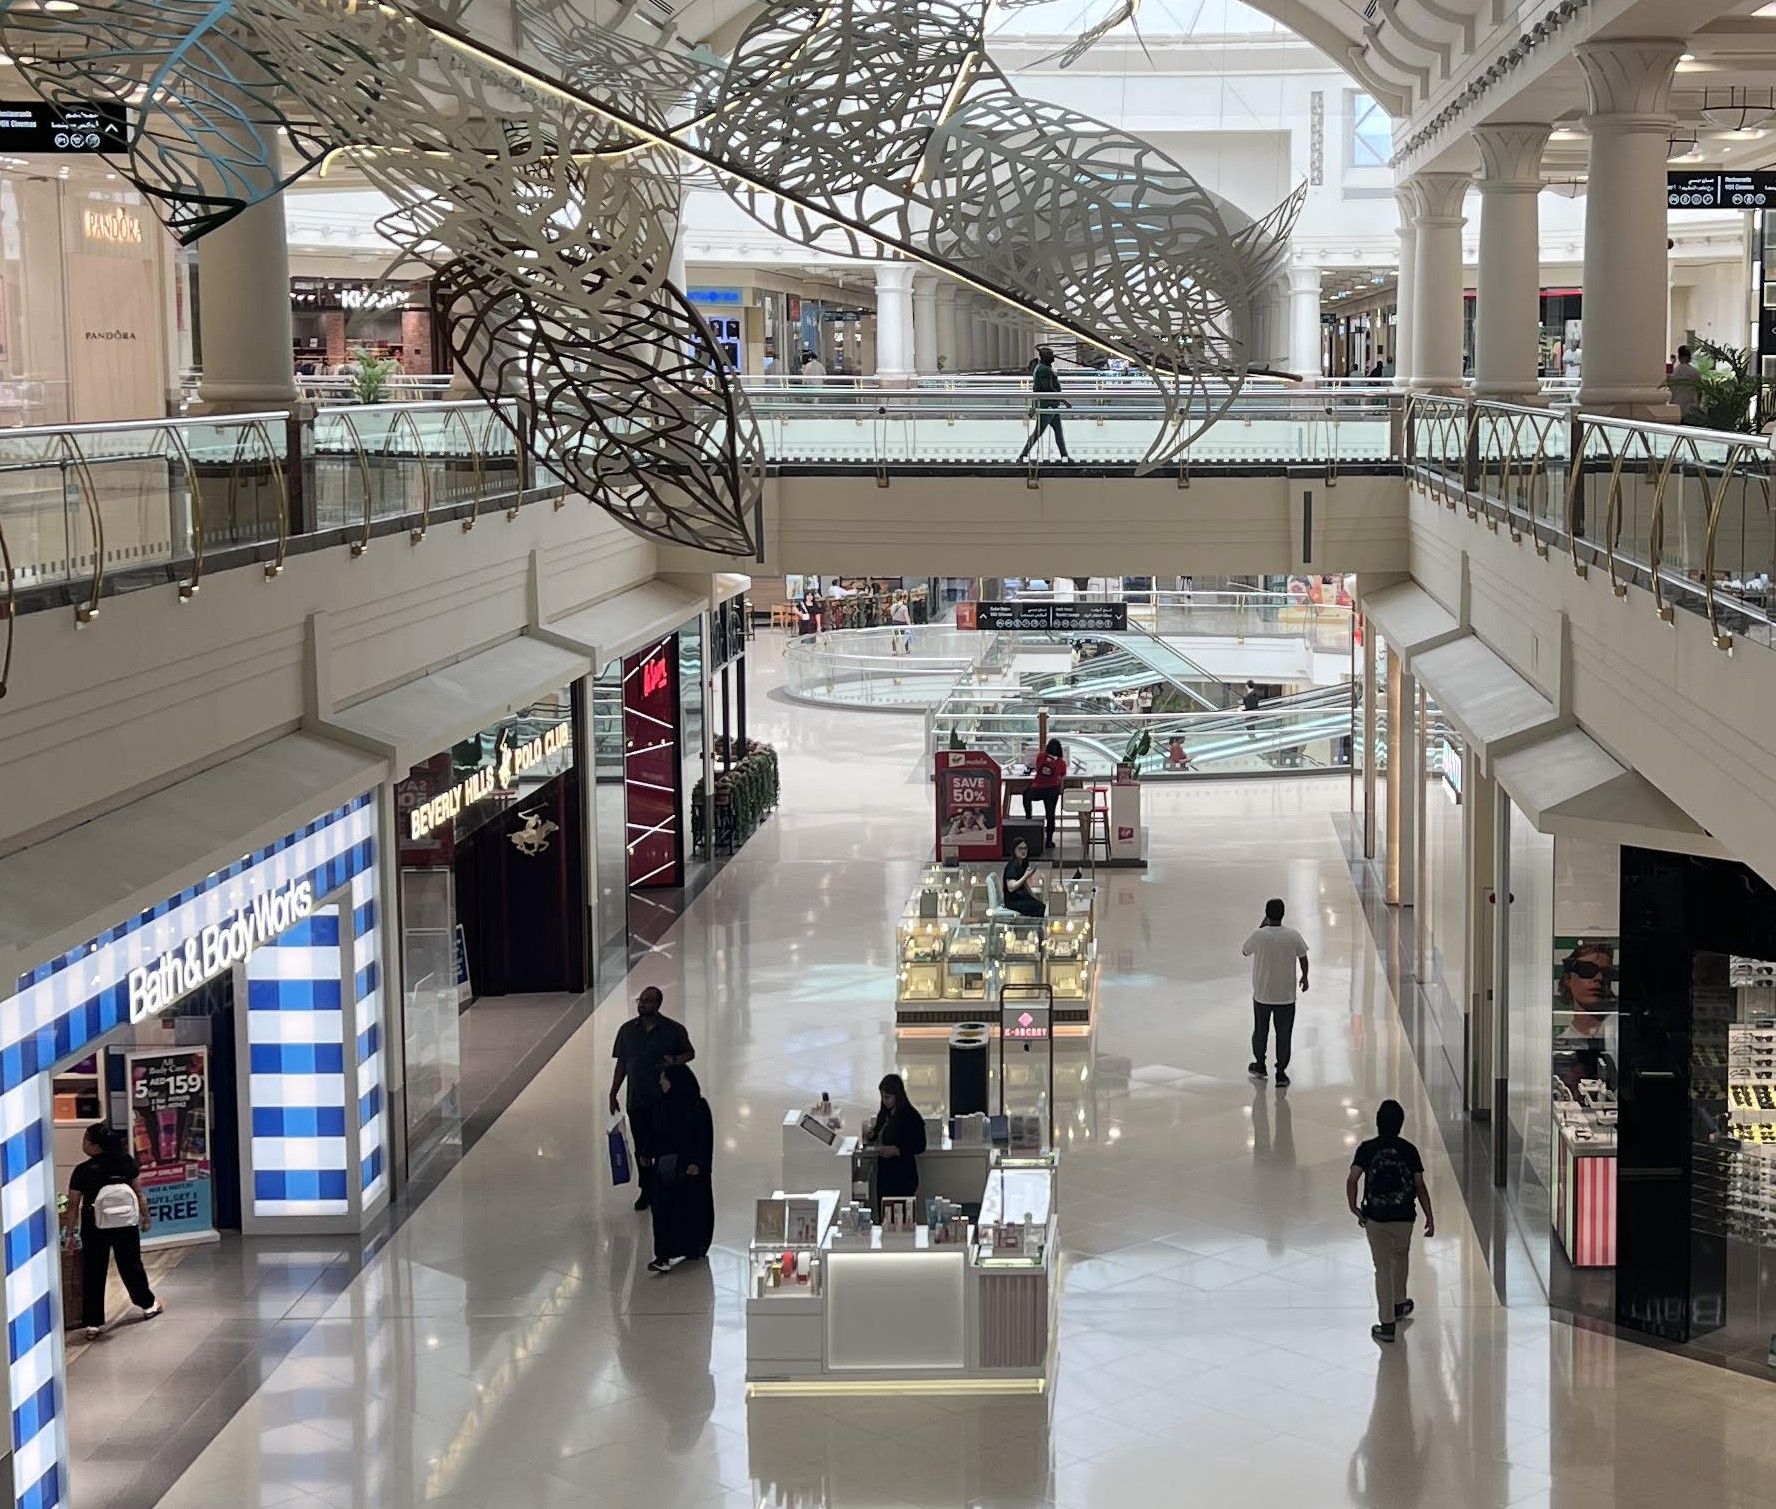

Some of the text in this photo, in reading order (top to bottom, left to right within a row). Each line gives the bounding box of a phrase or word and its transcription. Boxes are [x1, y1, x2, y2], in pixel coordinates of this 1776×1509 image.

[410, 722, 569, 840] BEVERLY HILLS POLO CLUB
[953, 777, 985, 788] SAVE
[953, 788, 986, 802] 50%
[128, 879, 312, 1025] Bath & Body Works
[134, 1073, 202, 1099] 5 AED 159
[173, 1192, 190, 1201] GET
[148, 1200, 198, 1222] FREE
